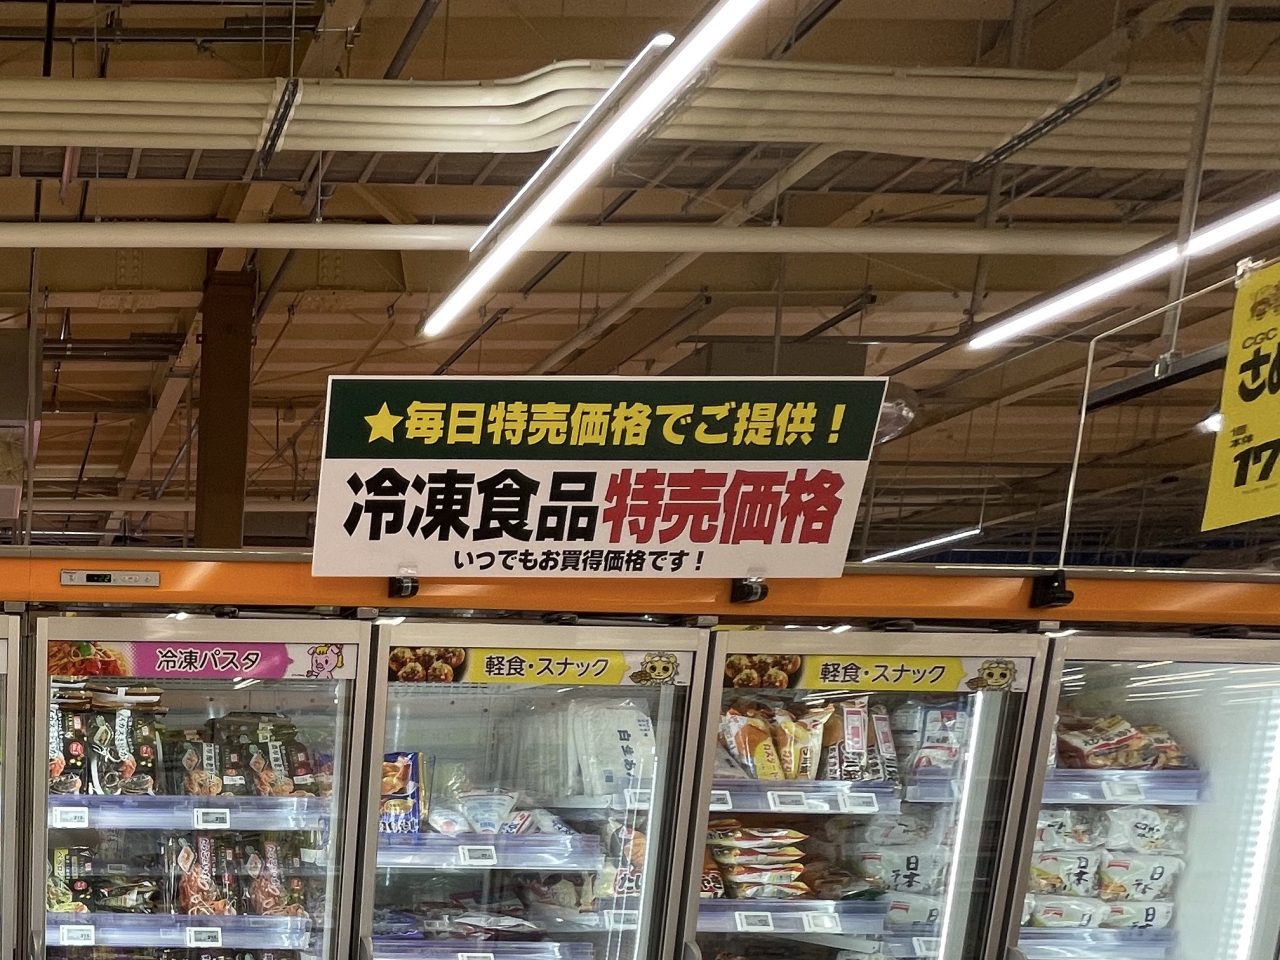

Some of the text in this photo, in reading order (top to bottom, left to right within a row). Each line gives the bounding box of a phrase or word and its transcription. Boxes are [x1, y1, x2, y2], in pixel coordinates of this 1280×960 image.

[1242, 327, 1277, 349] CGC
[405, 402, 845, 447] 毎日特売価格でご提供！
[343, 467, 846, 545] 冷凍食品特売価格
[454, 549, 704, 572] いつでもお買得価格です！
[156, 647, 262, 673] 冷凍パスタ
[485, 655, 610, 679] 軽食・スナック
[819, 662, 947, 685] 軽食・スナック
